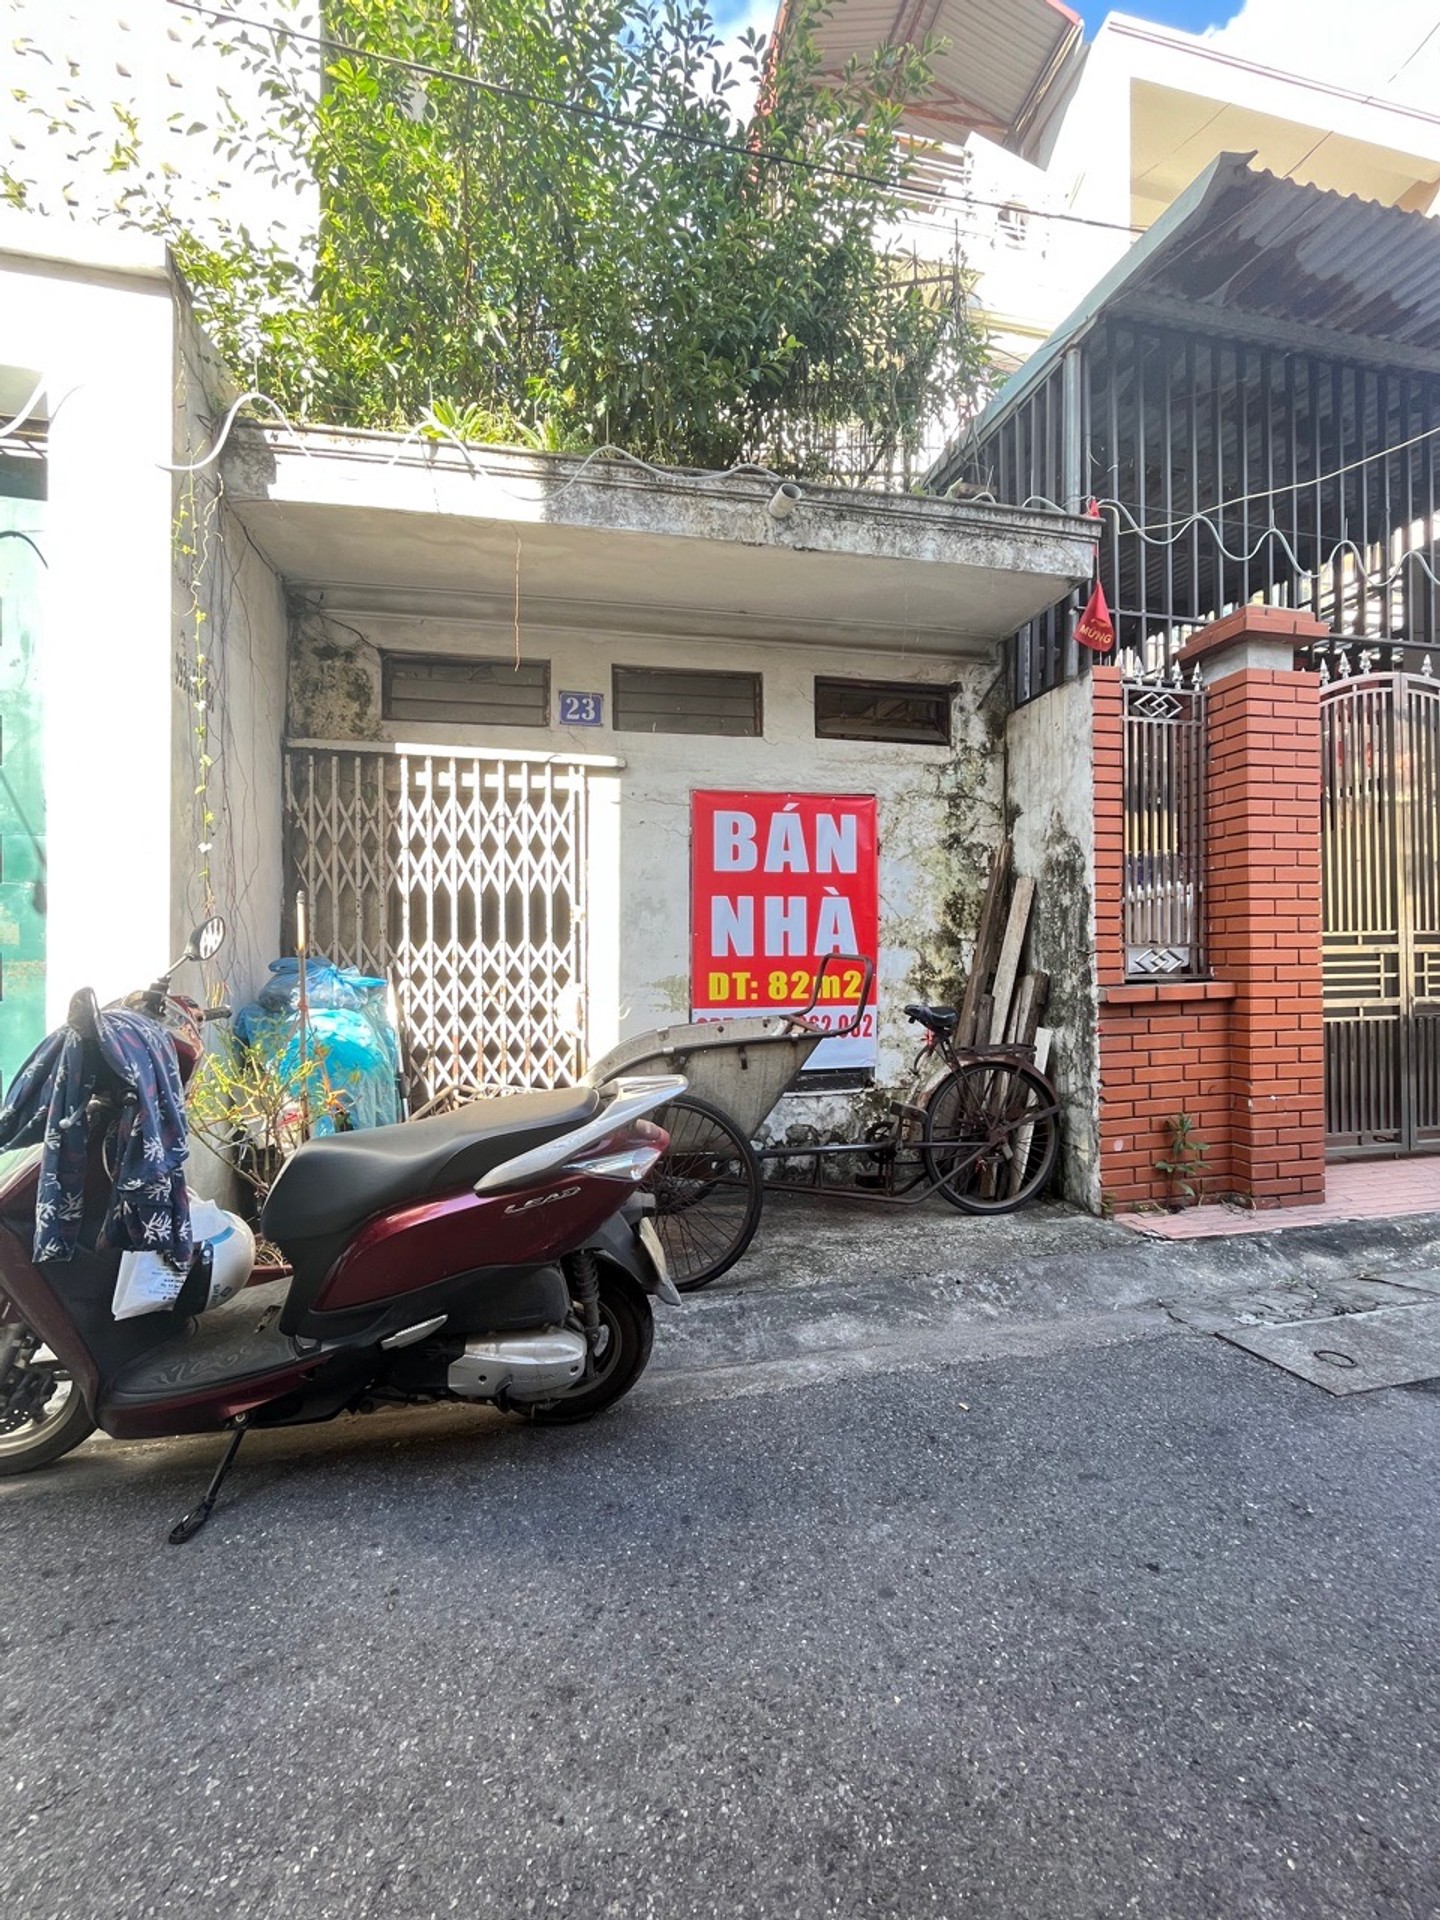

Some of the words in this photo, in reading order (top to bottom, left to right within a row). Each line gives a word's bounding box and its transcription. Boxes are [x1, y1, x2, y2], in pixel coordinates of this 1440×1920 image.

[565, 697, 596, 720] 23
[713, 802, 857, 874] BÁN
[710, 886, 859, 957] NHÀ
[708, 971, 759, 1001] DT:
[503, 1186, 582, 1215] LEAD
